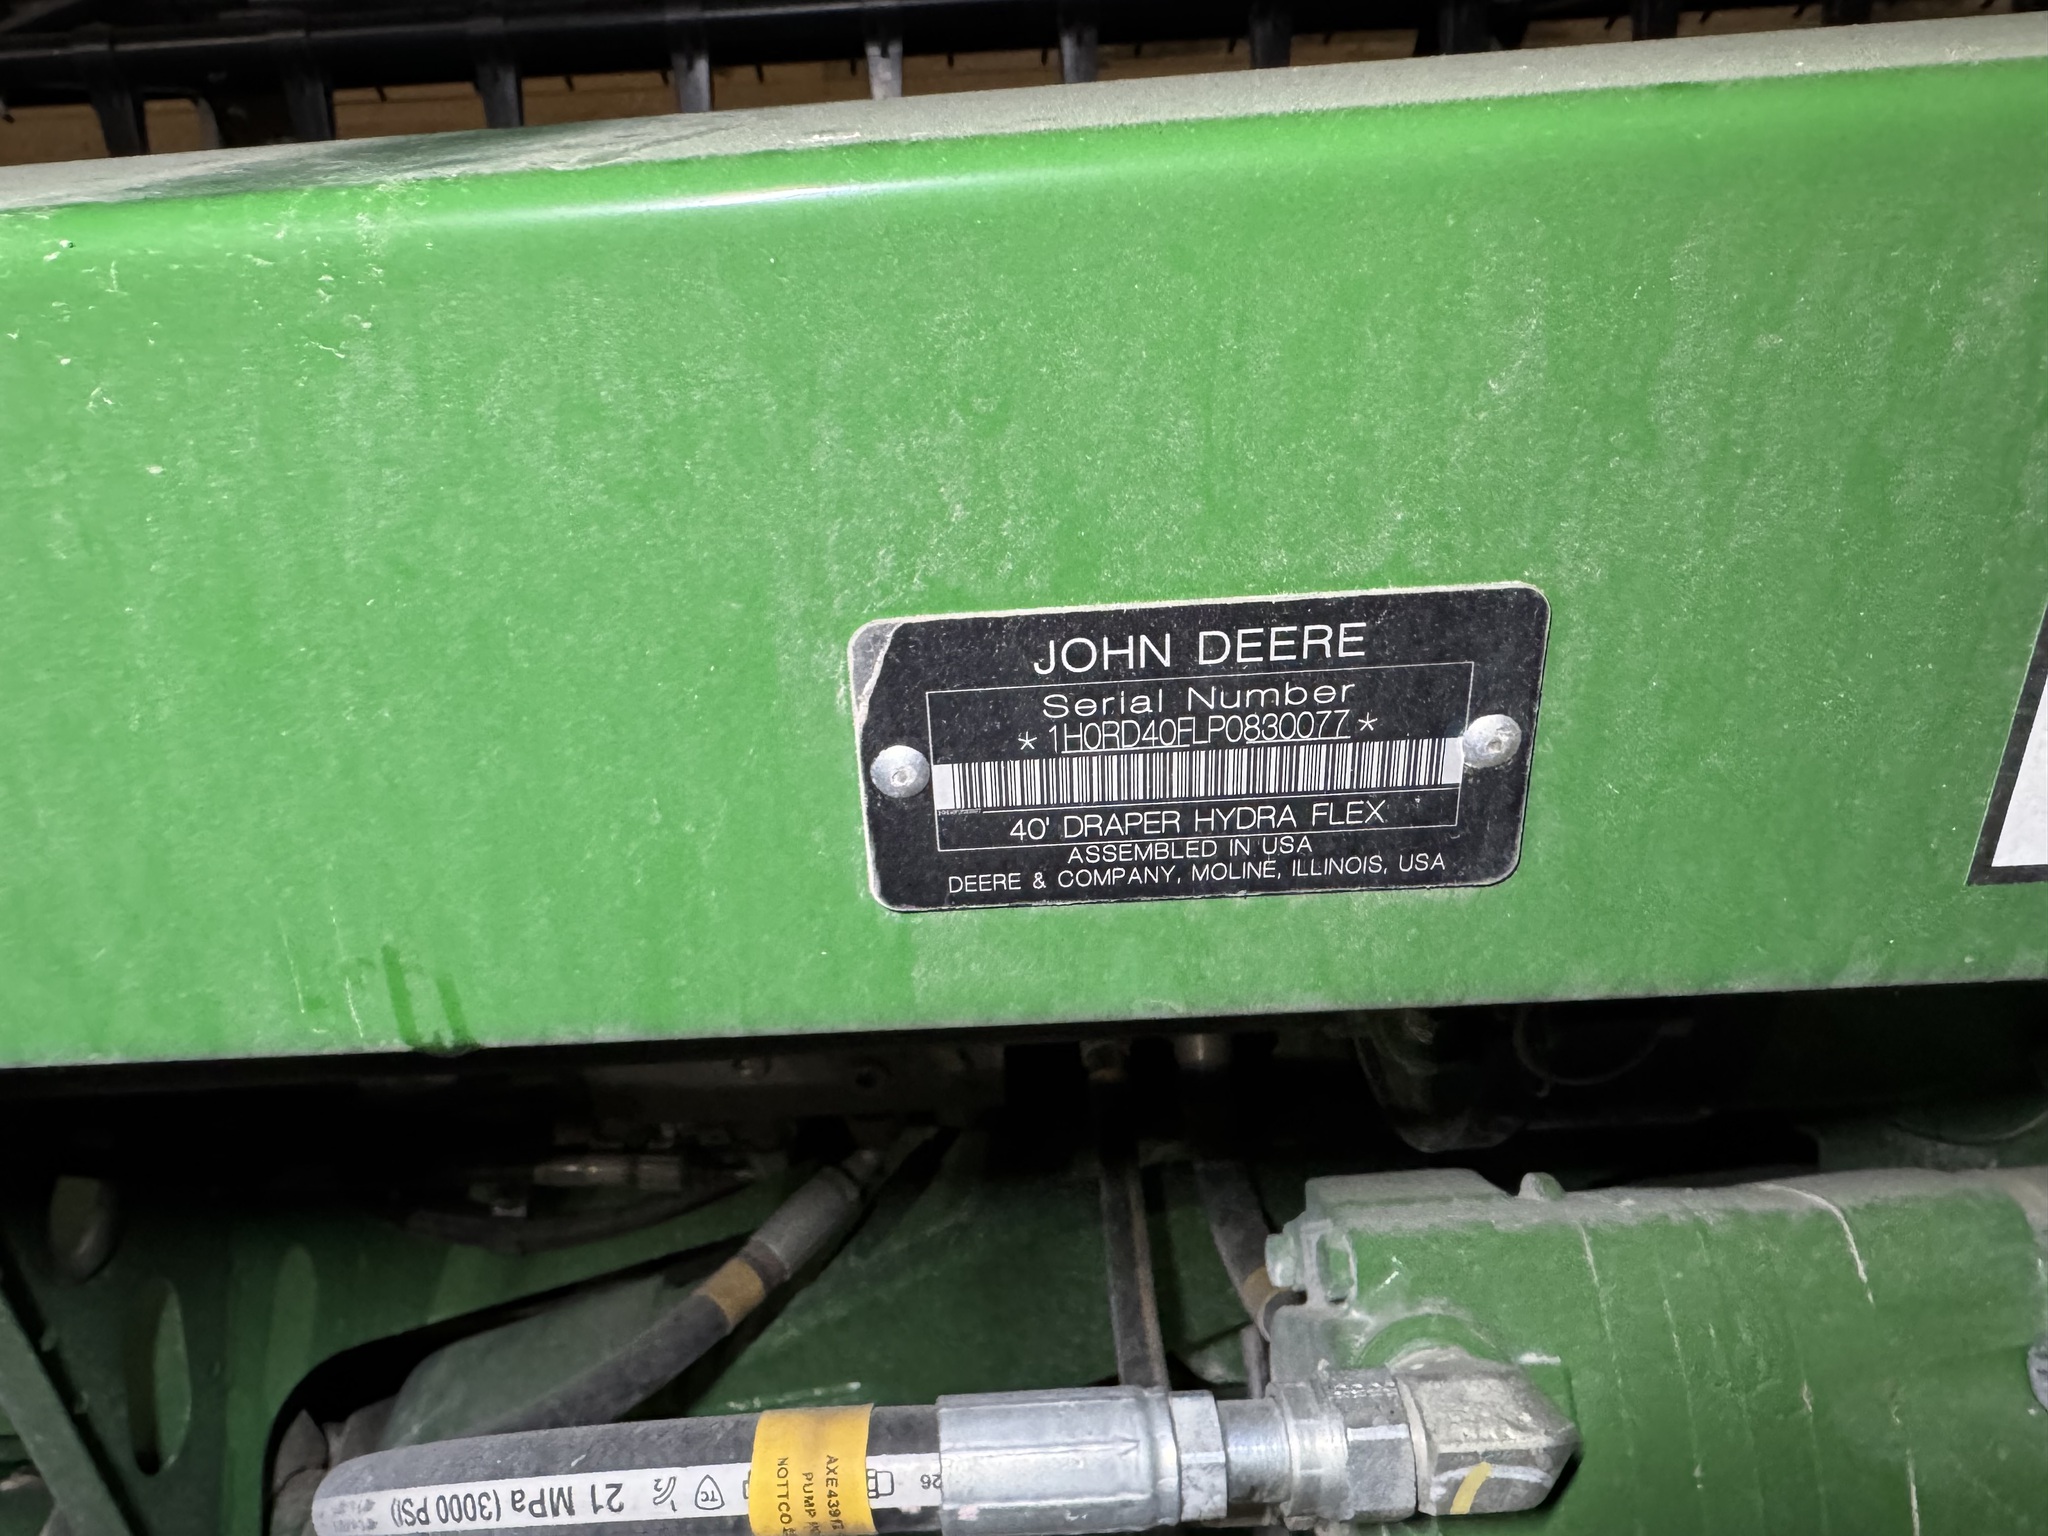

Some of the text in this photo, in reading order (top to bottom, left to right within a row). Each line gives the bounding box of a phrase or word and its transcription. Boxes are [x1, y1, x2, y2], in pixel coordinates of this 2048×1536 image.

[1033, 622, 1367, 675] JOHN DEERE
[1042, 682, 1355, 719] Serial Number
[1010, 799, 1386, 841] 40' DRAPER HYDRA FLEX
[1067, 835, 1313, 864] ASSEMBLED IN USA
[948, 852, 1446, 894] DEERE & COMPANY, MOLINE, ILLINOIS, USA
[390, 1496, 430, 1528] PSI)
[435, 1489, 502, 1525] (3000
[511, 1486, 576, 1519] MPa
[590, 1482, 625, 1513] 21
[701, 1490, 718, 1502] TC
[802, 1472, 816, 1518] PUMP
